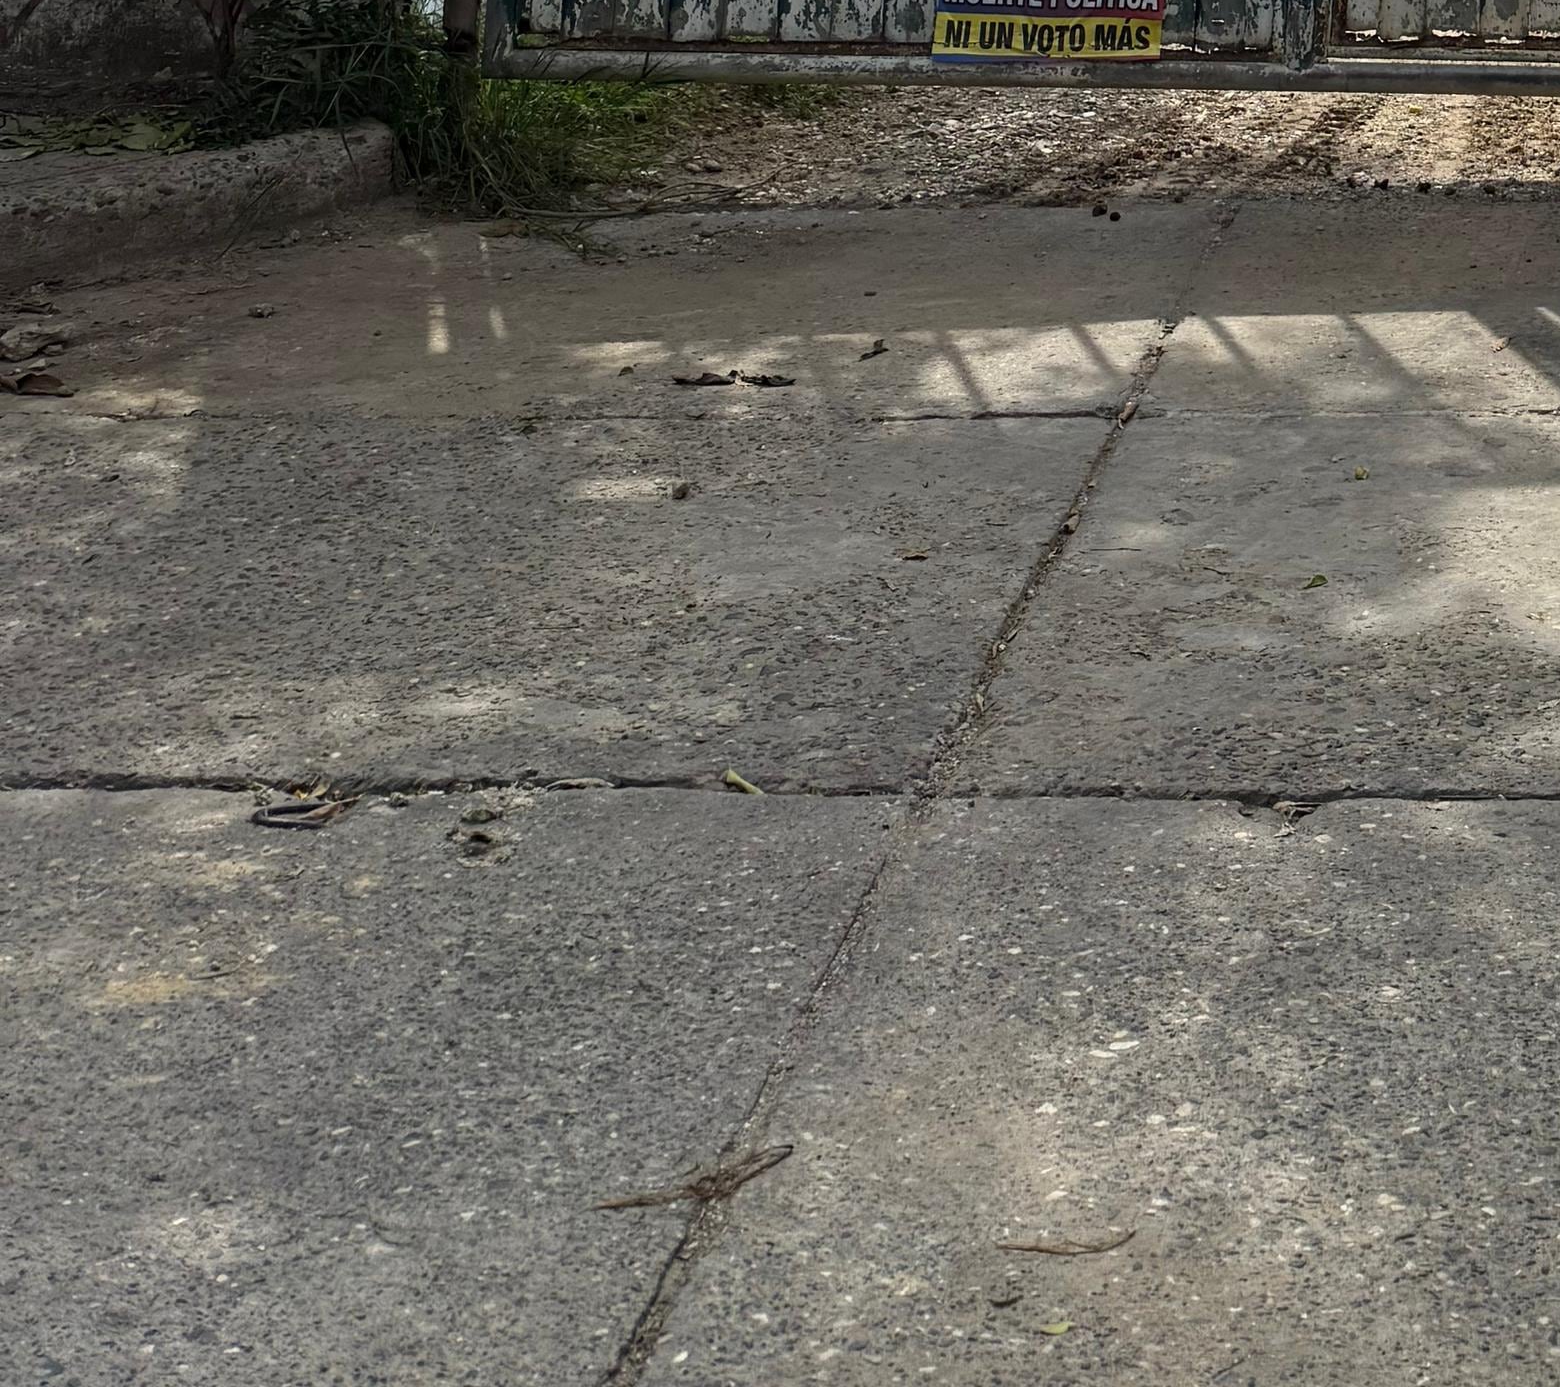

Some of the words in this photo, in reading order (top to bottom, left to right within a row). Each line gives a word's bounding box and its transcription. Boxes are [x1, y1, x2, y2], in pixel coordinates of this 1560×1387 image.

[944, 21, 971, 49] NI
[978, 22, 1015, 50] UN
[1019, 23, 1087, 52] VOTO
[1094, 19, 1153, 55] MÁS
